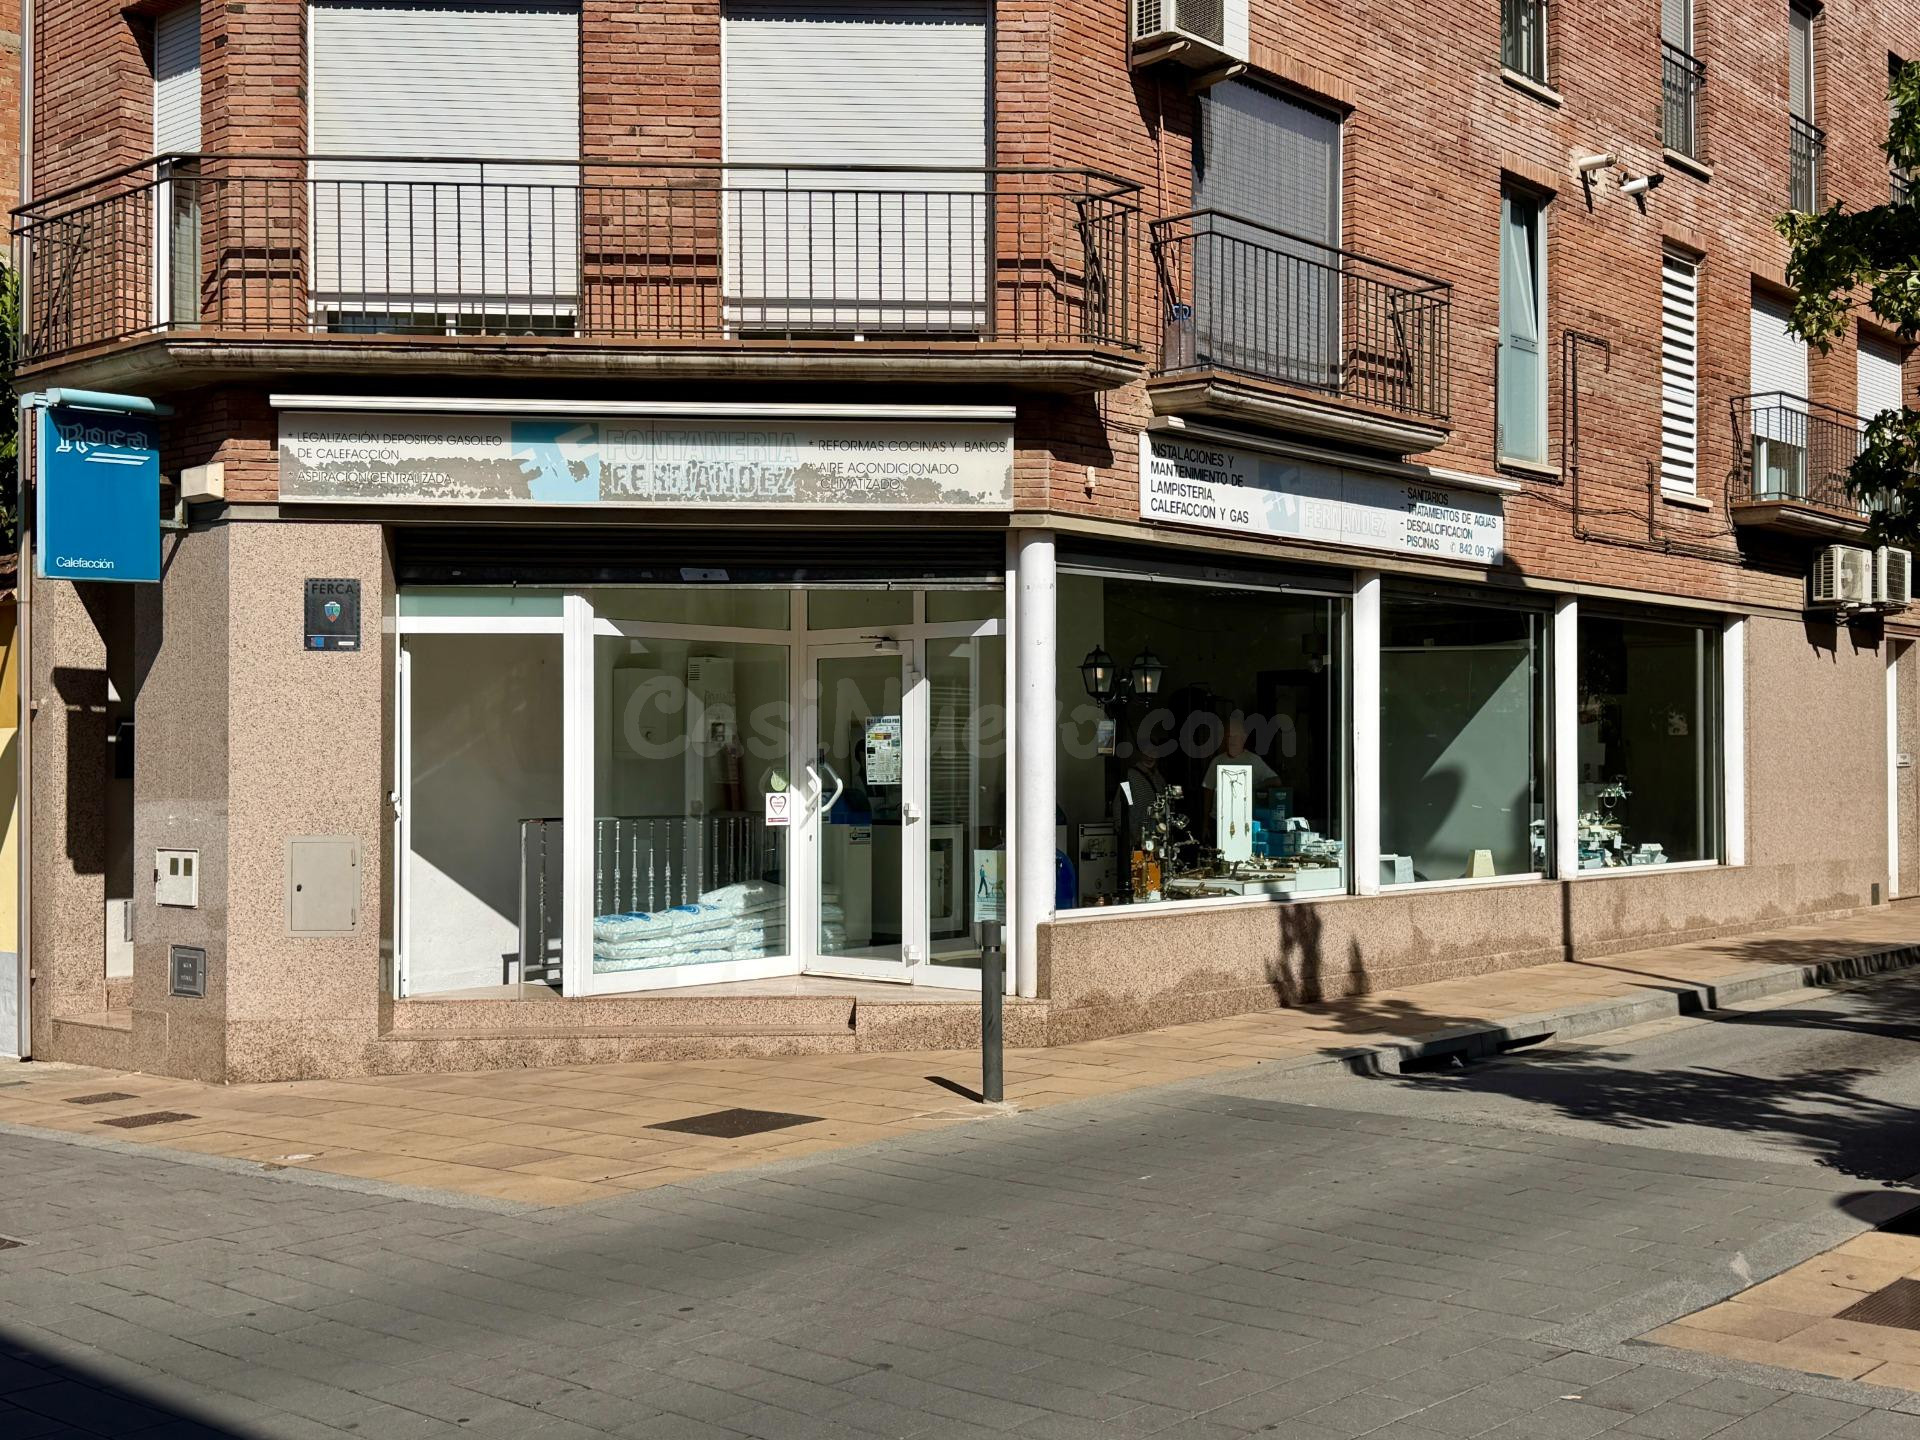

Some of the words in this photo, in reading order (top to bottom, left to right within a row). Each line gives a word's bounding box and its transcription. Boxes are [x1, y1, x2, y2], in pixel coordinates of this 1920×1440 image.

[56, 423, 149, 454] Roca
[383, 433, 443, 445] DEPOSITOS
[447, 435, 502, 446] GASOLEO
[606, 429, 799, 462] FONTANERIA
[818, 439, 884, 452] REFORMAS
[888, 440, 946, 452] COCINAS
[949, 441, 957, 452] Y
[297, 448, 313, 458] DE
[818, 462, 843, 474] AIRE
[849, 463, 959, 475] ACONDICIONADO
[1229, 455, 1235, 468] Y
[1151, 461, 1228, 485] MANTENIMIENTO
[1231, 474, 1244, 487] DE
[1407, 488, 1449, 505] SANITARIOS
[1151, 497, 1216, 520] CALEFACCION
[1220, 507, 1226, 521] Y
[1229, 509, 1249, 524] GAS
[1407, 504, 1460, 523] TRATAMIENTOS
[1461, 513, 1472, 525] DE
[1474, 515, 1497, 529] AGUAS
[1406, 519, 1473, 540] DESCALCIFICACION
[1406, 537, 1440, 551] PISCINAS
[1459, 543, 1474, 555] 842
[1475, 546, 1486, 557] 09
[1487, 547, 1496, 559] 73
[56, 556, 115, 569] Calefacción
[311, 583, 354, 594] FERCA
